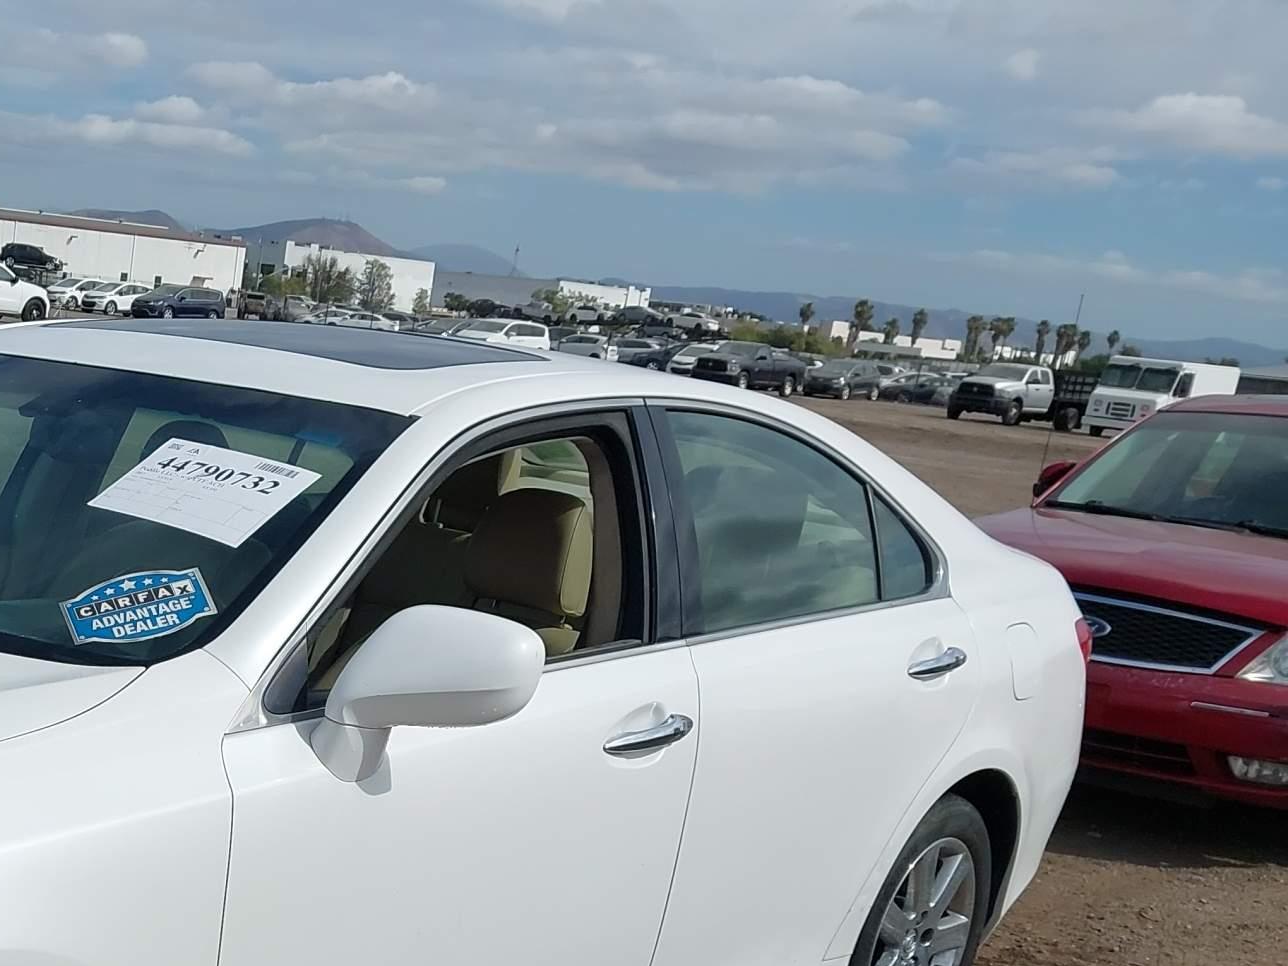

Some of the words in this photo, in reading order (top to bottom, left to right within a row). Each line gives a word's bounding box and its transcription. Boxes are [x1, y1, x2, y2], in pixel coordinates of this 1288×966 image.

[157, 456, 281, 495] 44790732
[78, 583, 192, 617] CARFAX
[91, 597, 193, 631] ADVANTAGE
[112, 613, 181, 638] DEALER
